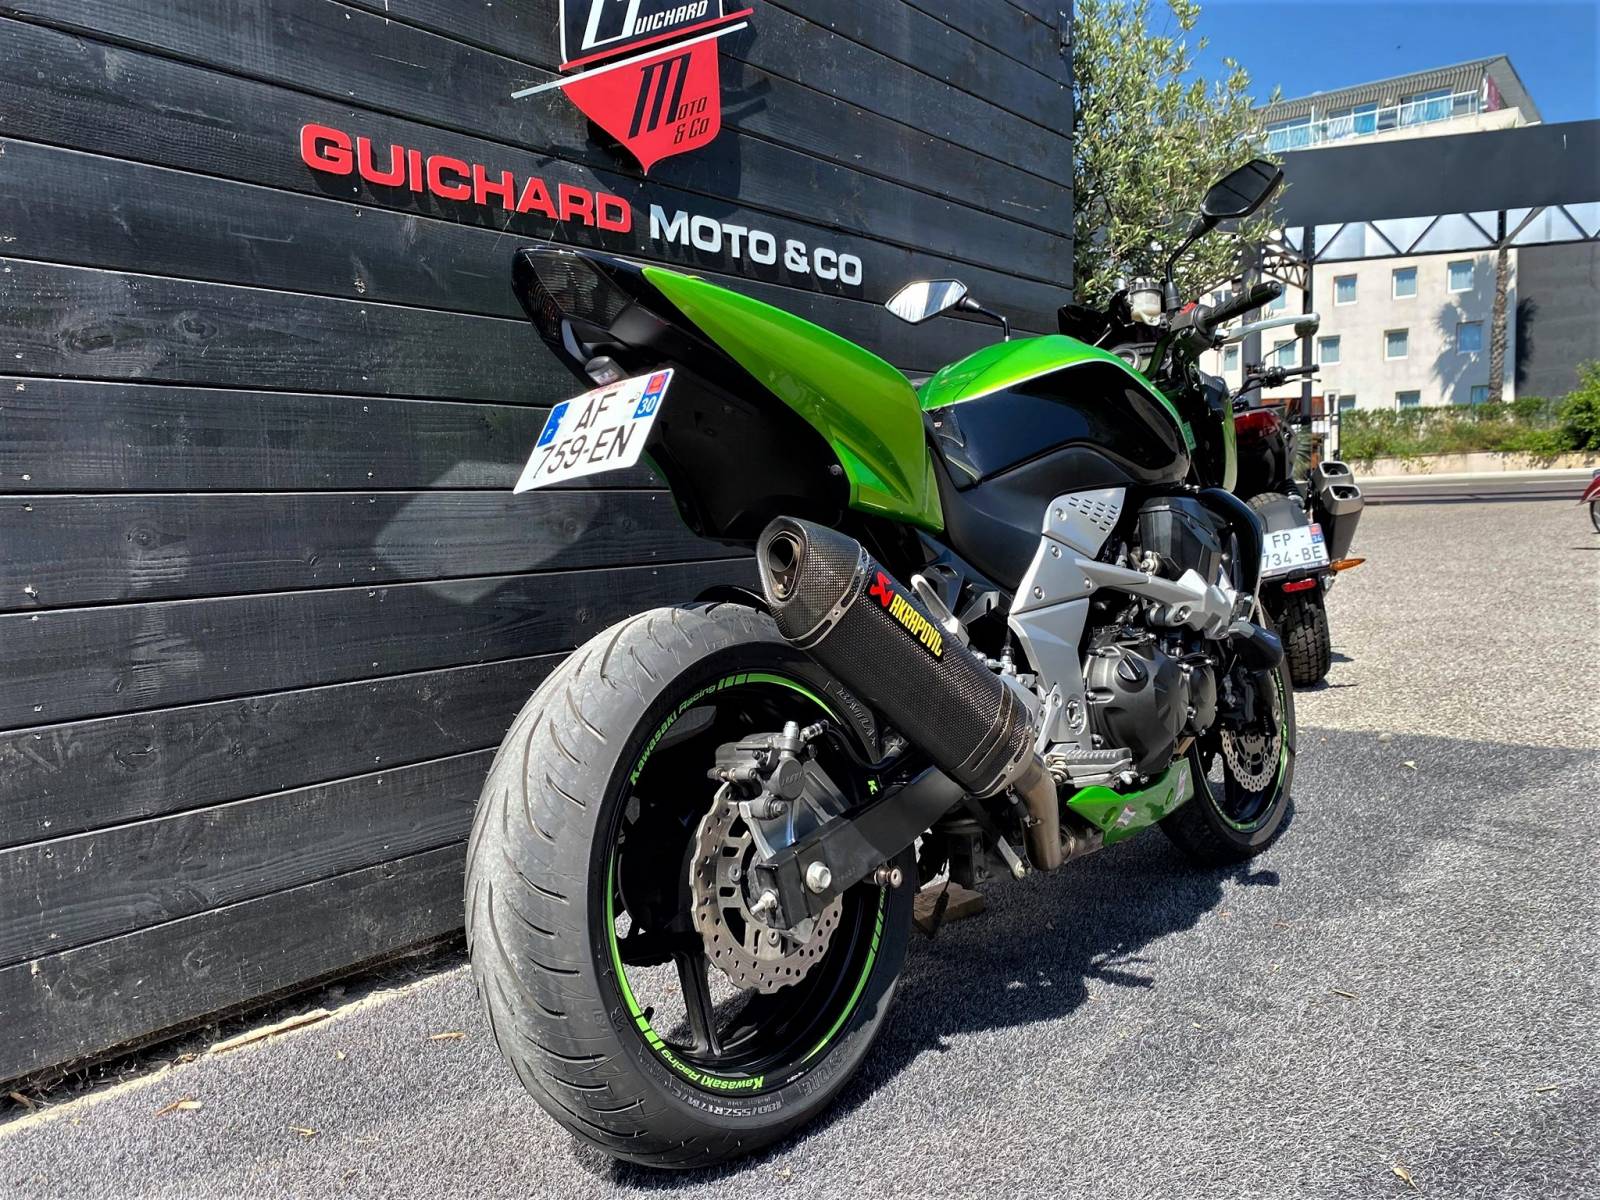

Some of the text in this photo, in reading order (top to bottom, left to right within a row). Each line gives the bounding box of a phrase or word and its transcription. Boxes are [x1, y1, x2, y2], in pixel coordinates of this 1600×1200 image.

[300, 123, 632, 233] GUICHARD
[649, 204, 777, 264] MOTO
[573, 392, 619, 432] AF
[638, 395, 658, 415] 30
[544, 429, 554, 440] F
[533, 422, 637, 479] 759-EN
[1272, 533, 1291, 548] FP
[1262, 545, 1323, 568] 734-BE
[629, 684, 716, 786] Kawasaki Racing
[660, 1049, 701, 1086] Racing
[700, 1074, 764, 1090] Kawasaki
